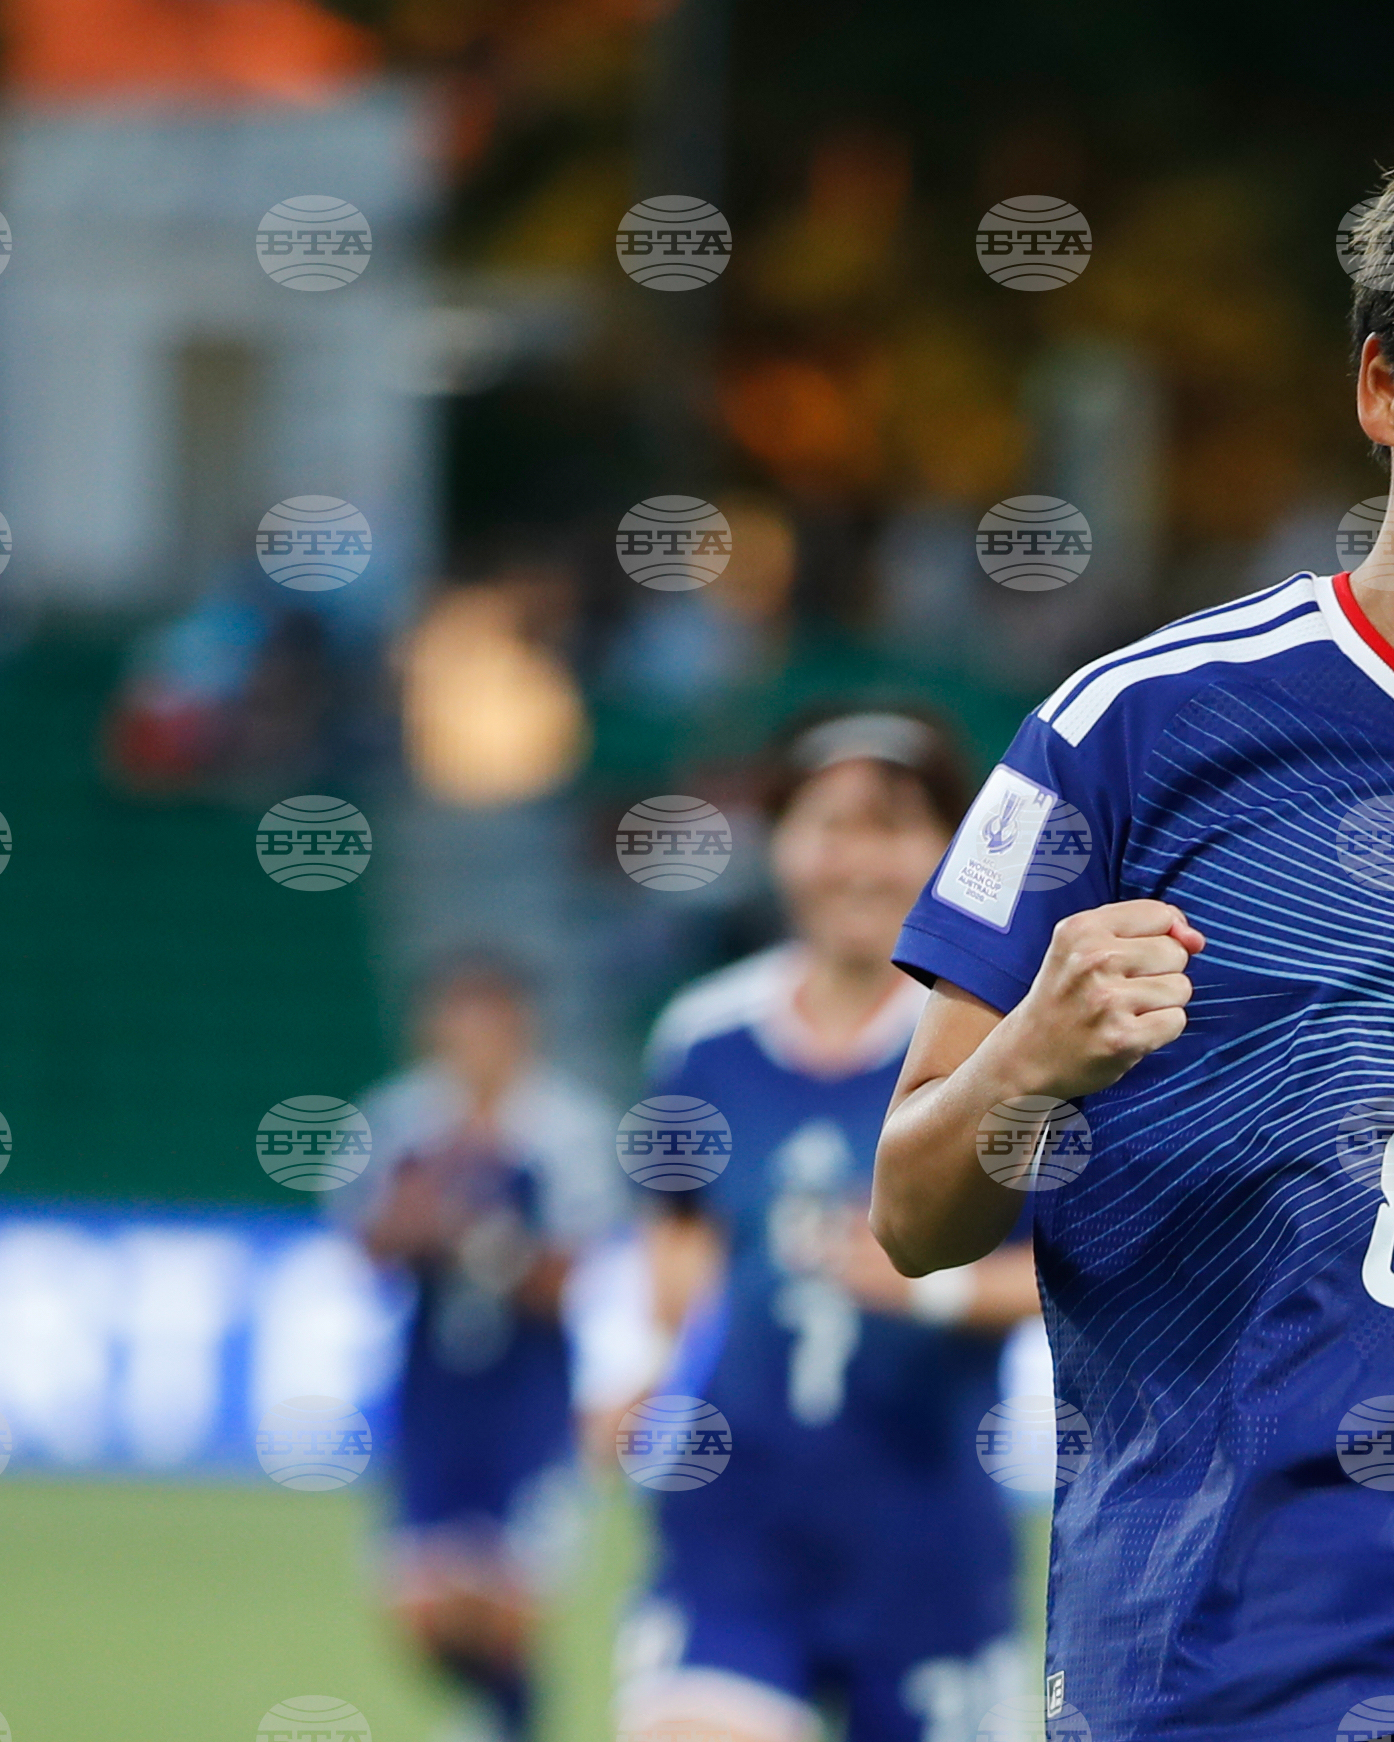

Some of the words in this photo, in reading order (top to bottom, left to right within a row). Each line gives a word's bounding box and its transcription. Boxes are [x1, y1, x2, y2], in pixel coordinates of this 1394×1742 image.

[958, 875, 997, 900] AUSTRALIA
[961, 867, 985, 884] ASIAN
[985, 878, 1001, 890] CUP
